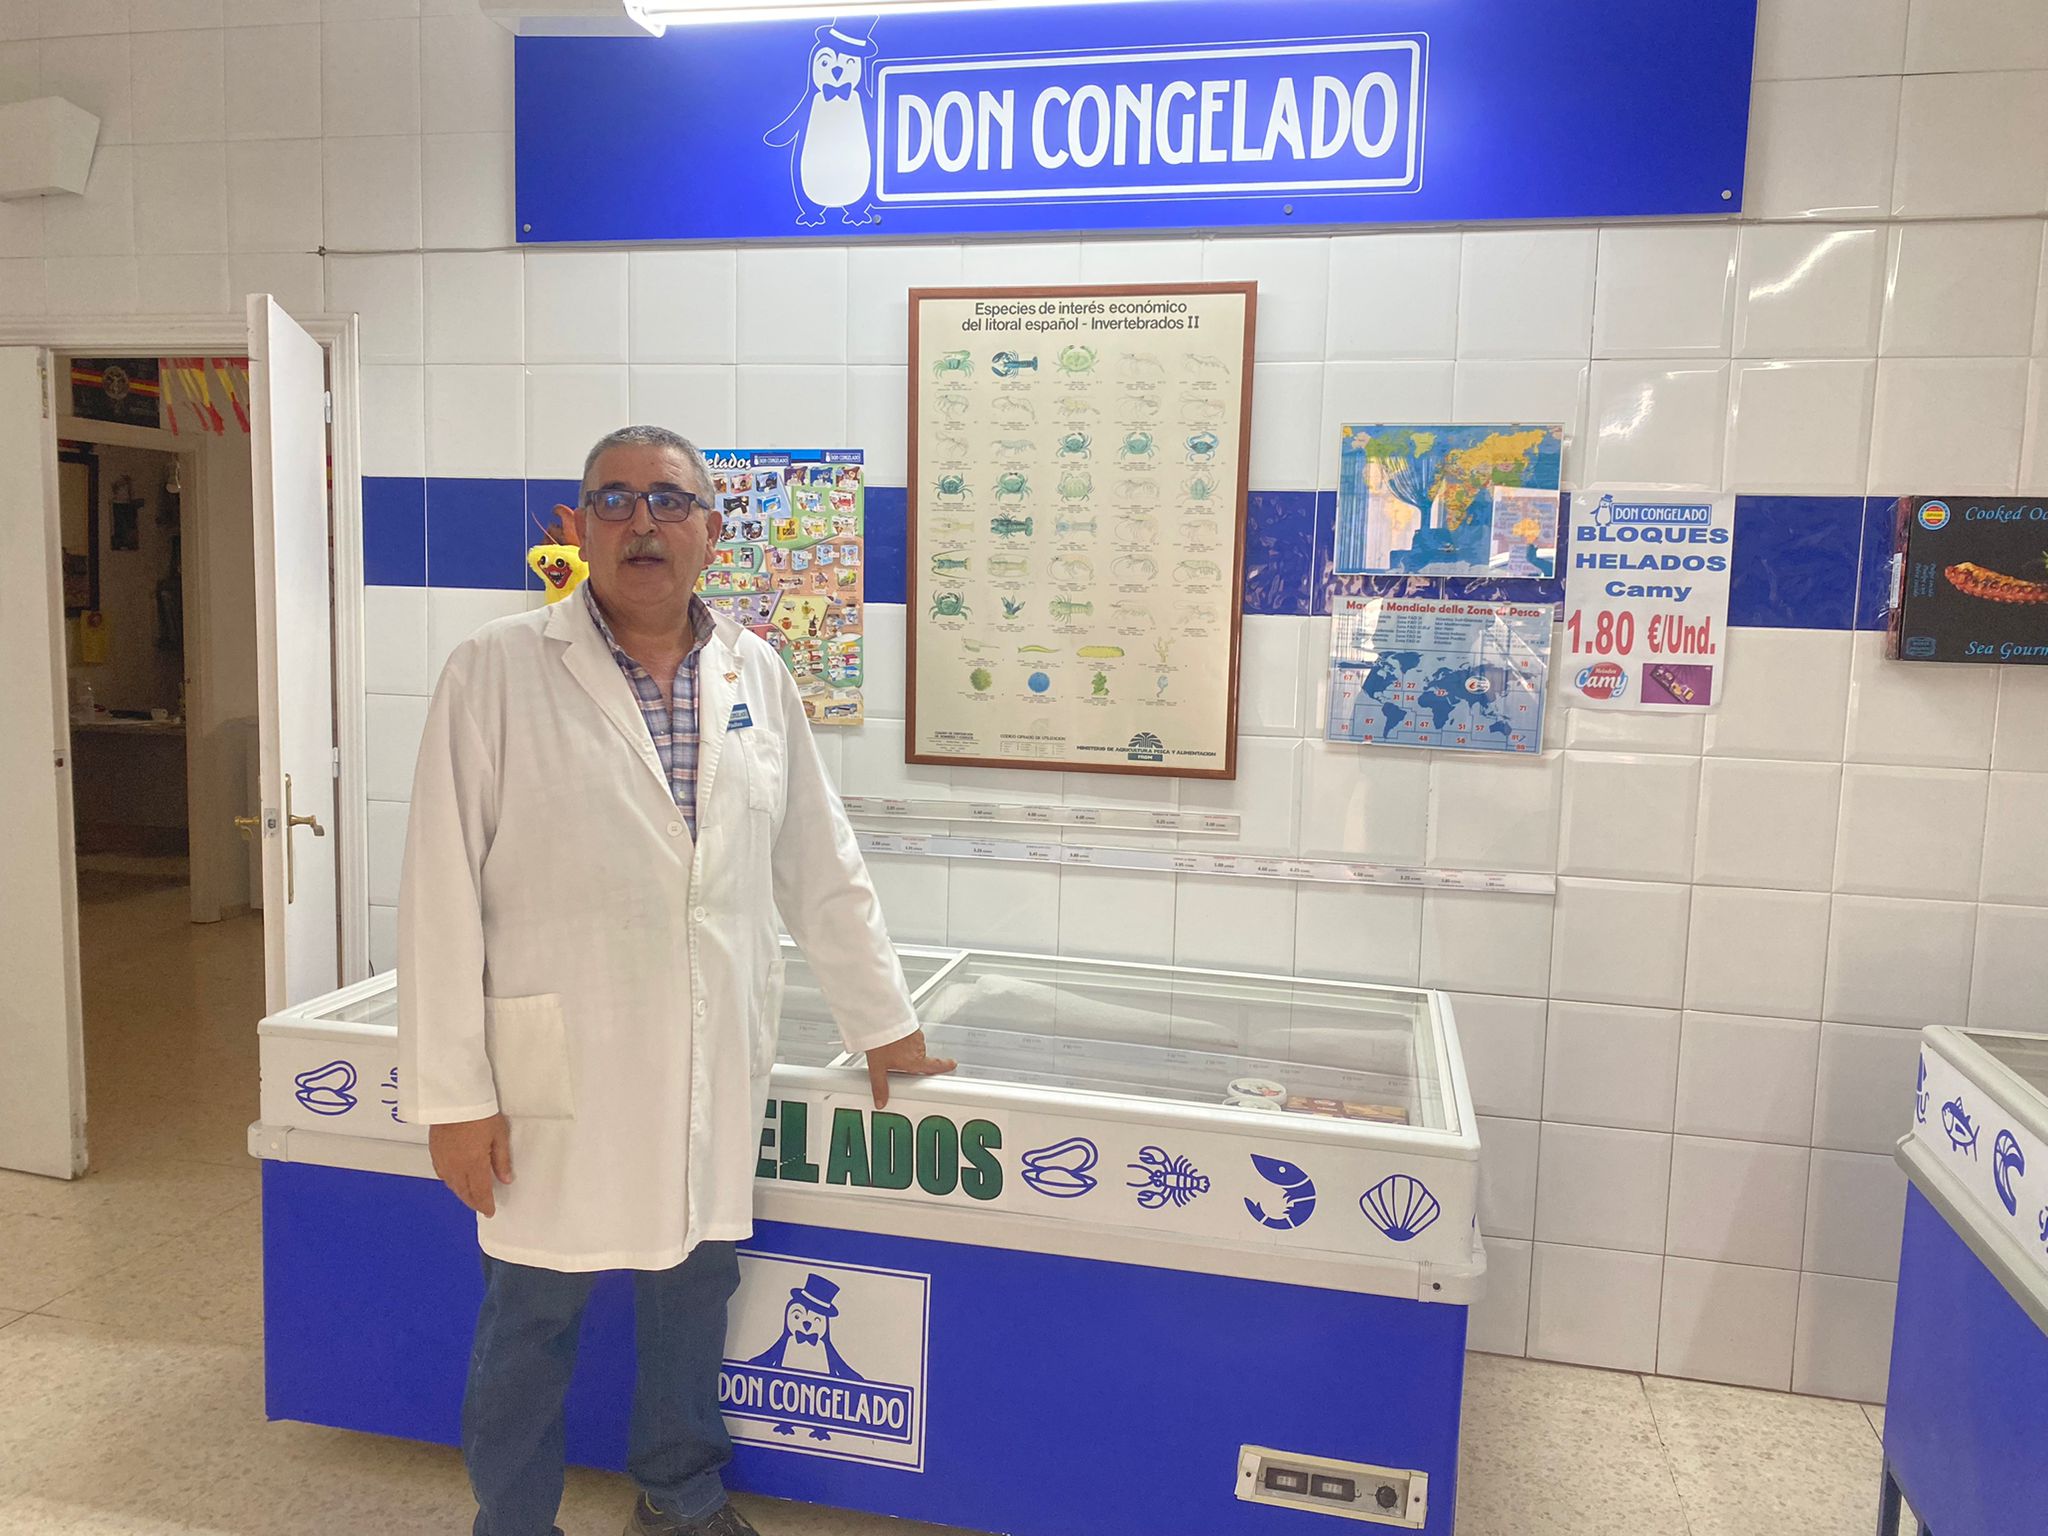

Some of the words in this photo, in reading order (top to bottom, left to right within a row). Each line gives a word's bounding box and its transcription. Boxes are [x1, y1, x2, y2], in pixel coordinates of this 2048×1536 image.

[897, 88, 1014, 174] DON
[1031, 72, 1397, 170] CONGELADO
[975, 302, 1036, 318] Especies
[1039, 302, 1056, 315] de
[1058, 301, 1105, 314] interés
[1109, 300, 1187, 314] económico
[962, 318, 983, 332] del
[985, 317, 1022, 331] litoral
[1025, 317, 1079, 333] español
[1091, 316, 1184, 330] Invertebrados
[1188, 315, 1200, 329] II
[1615, 507, 1639, 520] DON
[1641, 507, 1707, 521] CONGELADO
[1965, 505, 2028, 523] Cooked
[1577, 526, 1729, 544] BLOQUES
[1576, 553, 1727, 571] HELADOS
[1605, 581, 1692, 602] Camy
[1387, 603, 1436, 614] Mondiale
[1439, 604, 1464, 615] delle
[1467, 606, 1494, 616] Zone
[1510, 607, 1541, 617] Pesca
[1568, 609, 1635, 656] 1.80
[1647, 614, 1716, 655] €/Und.
[1965, 641, 1994, 655] Sea
[1575, 667, 1629, 697] Camy
[718, 1372, 763, 1408] DON
[769, 1379, 905, 1429] CONGELADO
